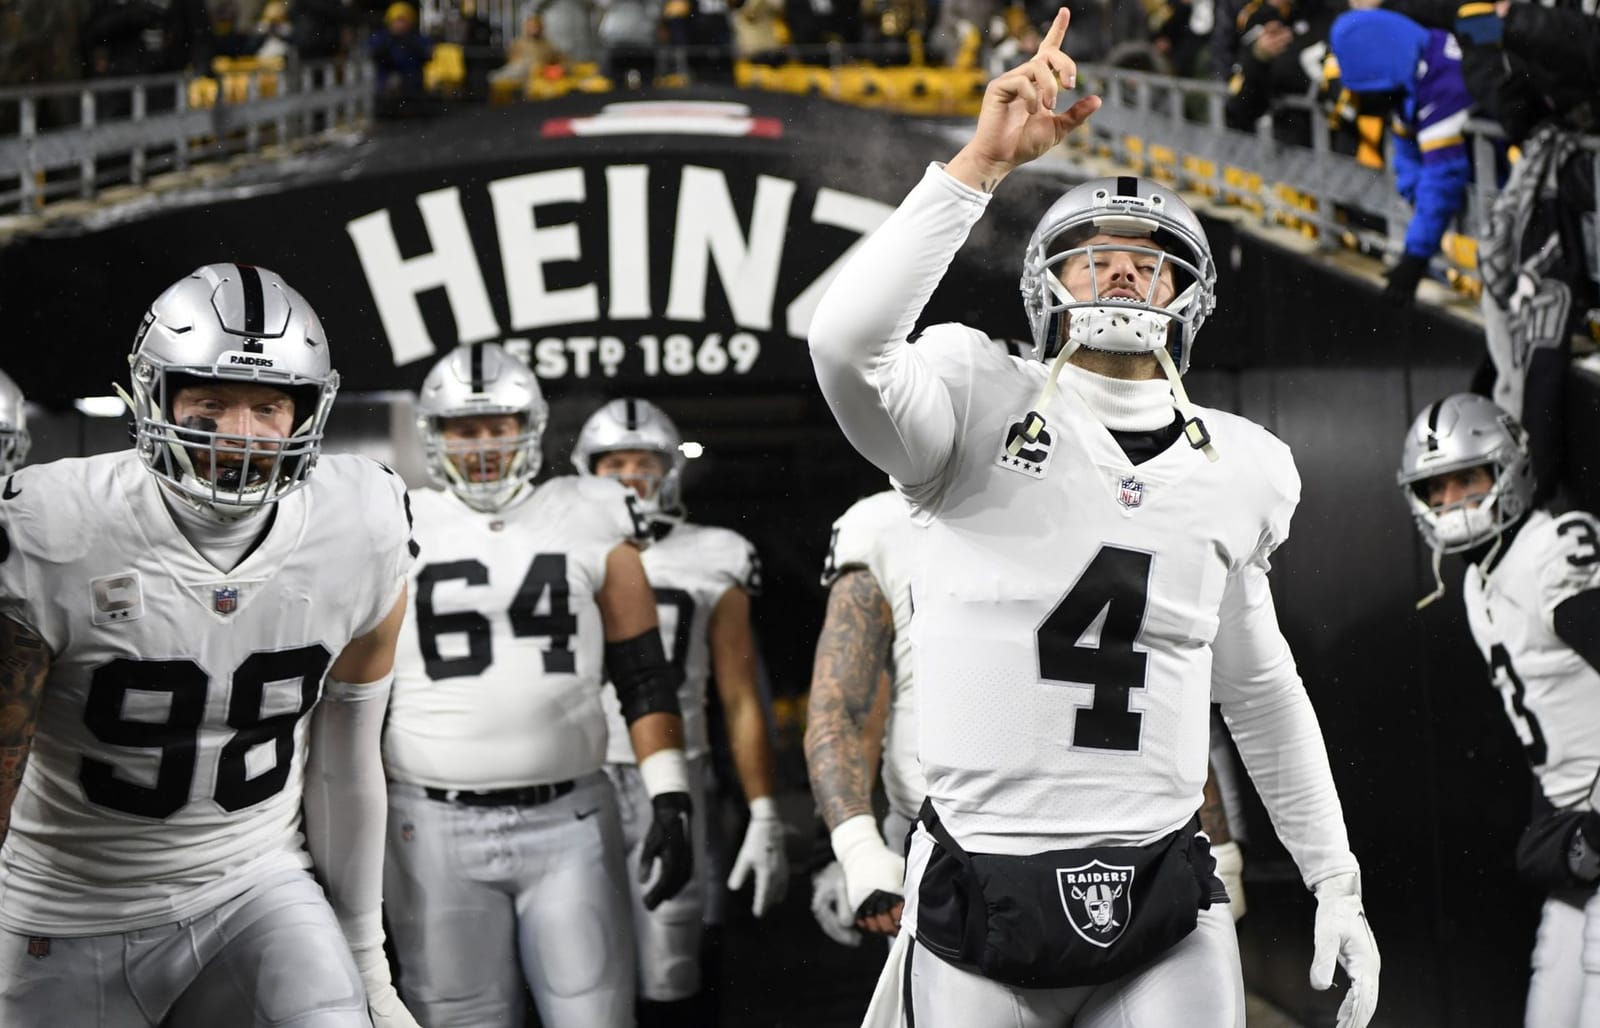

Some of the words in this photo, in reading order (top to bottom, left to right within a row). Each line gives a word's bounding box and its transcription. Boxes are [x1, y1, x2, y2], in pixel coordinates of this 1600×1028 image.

[230, 355, 274, 367] RAIDERS
[637, 332, 761, 376] 1869
[95, 576, 137, 613] C
[415, 552, 577, 681] 64
[1035, 543, 1153, 752] 4
[78, 643, 332, 820] 98
[1066, 871, 1128, 884] RAIDERS
